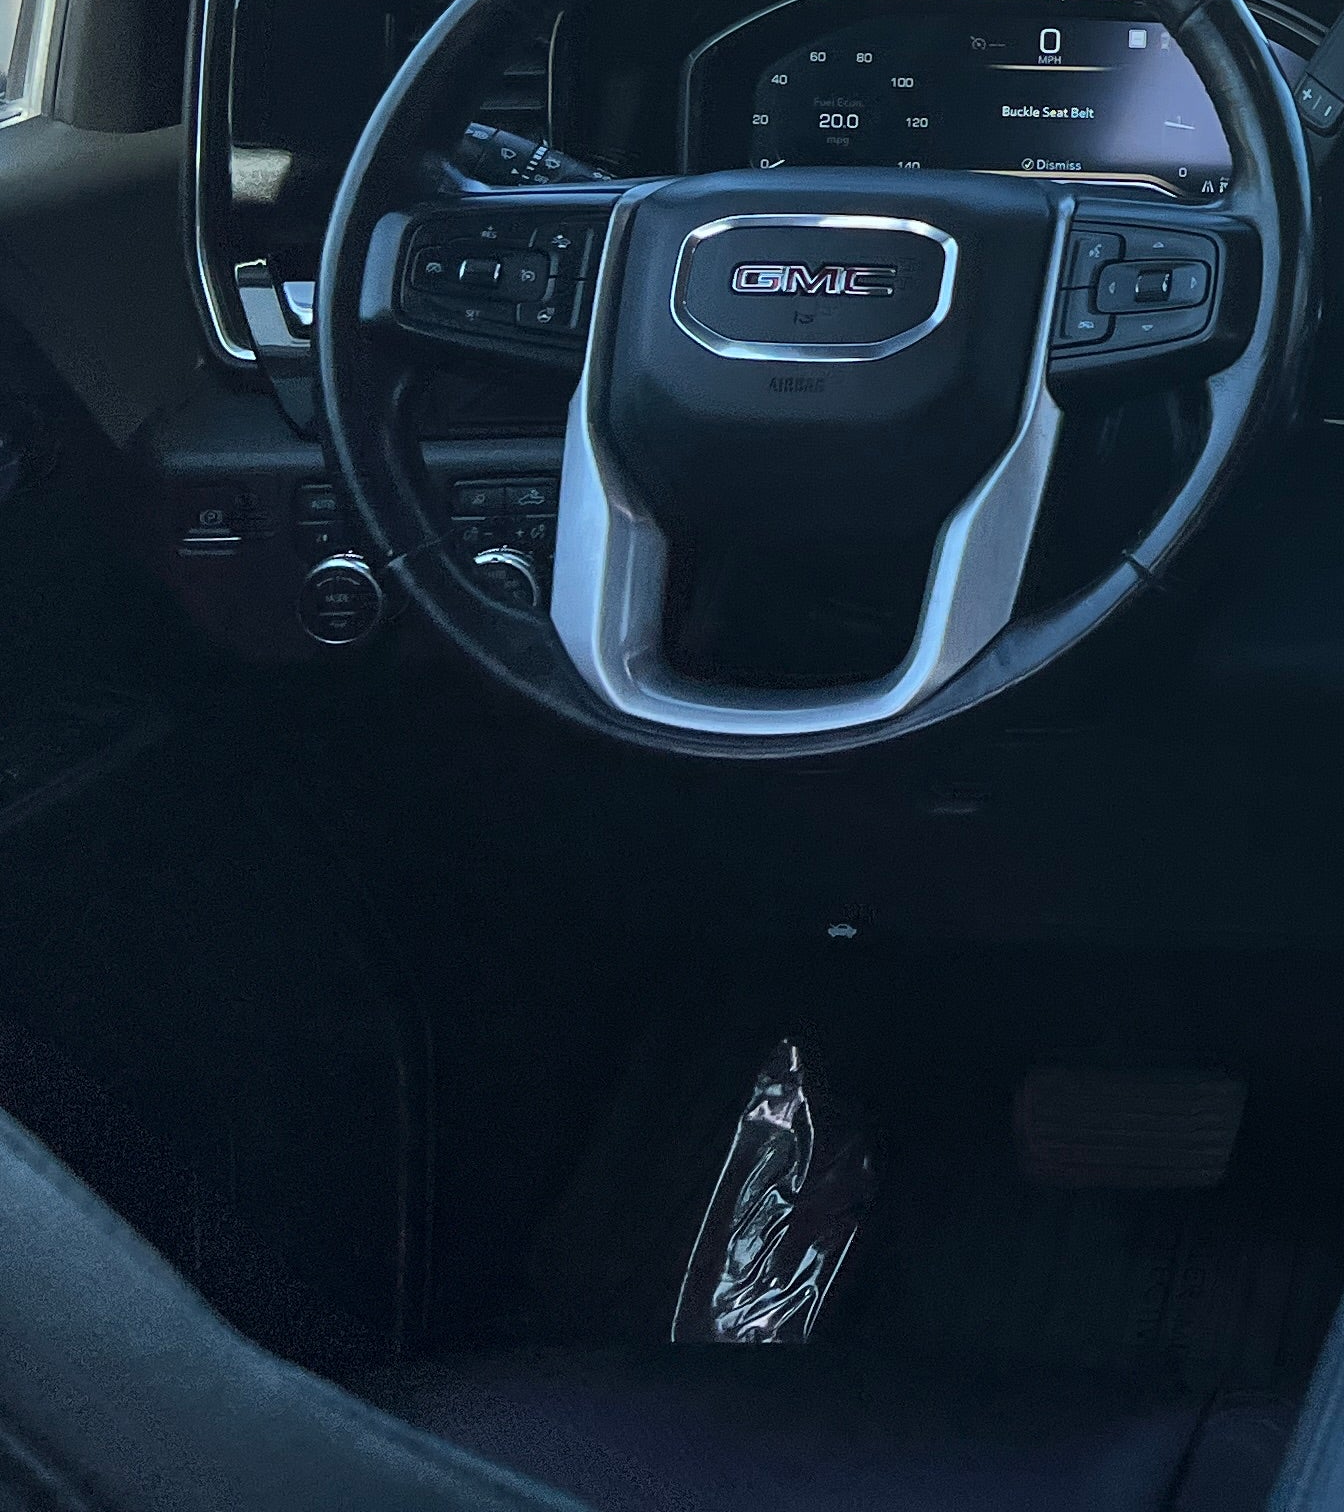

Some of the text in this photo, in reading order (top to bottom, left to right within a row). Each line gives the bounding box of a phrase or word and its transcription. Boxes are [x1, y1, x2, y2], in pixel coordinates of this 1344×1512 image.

[1040, 28, 1061, 54] 0
[810, 52, 827, 62] 60
[856, 52, 873, 63] 80
[1038, 55, 1062, 65] MPH
[771, 74, 788, 85] 40
[891, 77, 914, 88] 100
[1002, 106, 1095, 119] Buckle Seat Belt
[752, 114, 769, 125] 20
[819, 114, 859, 129] 20.0
[906, 117, 929, 128] 120
[827, 136, 850, 147] mpg
[1036, 160, 1081, 171] Dismiss
[731, 264, 897, 296] GMC
